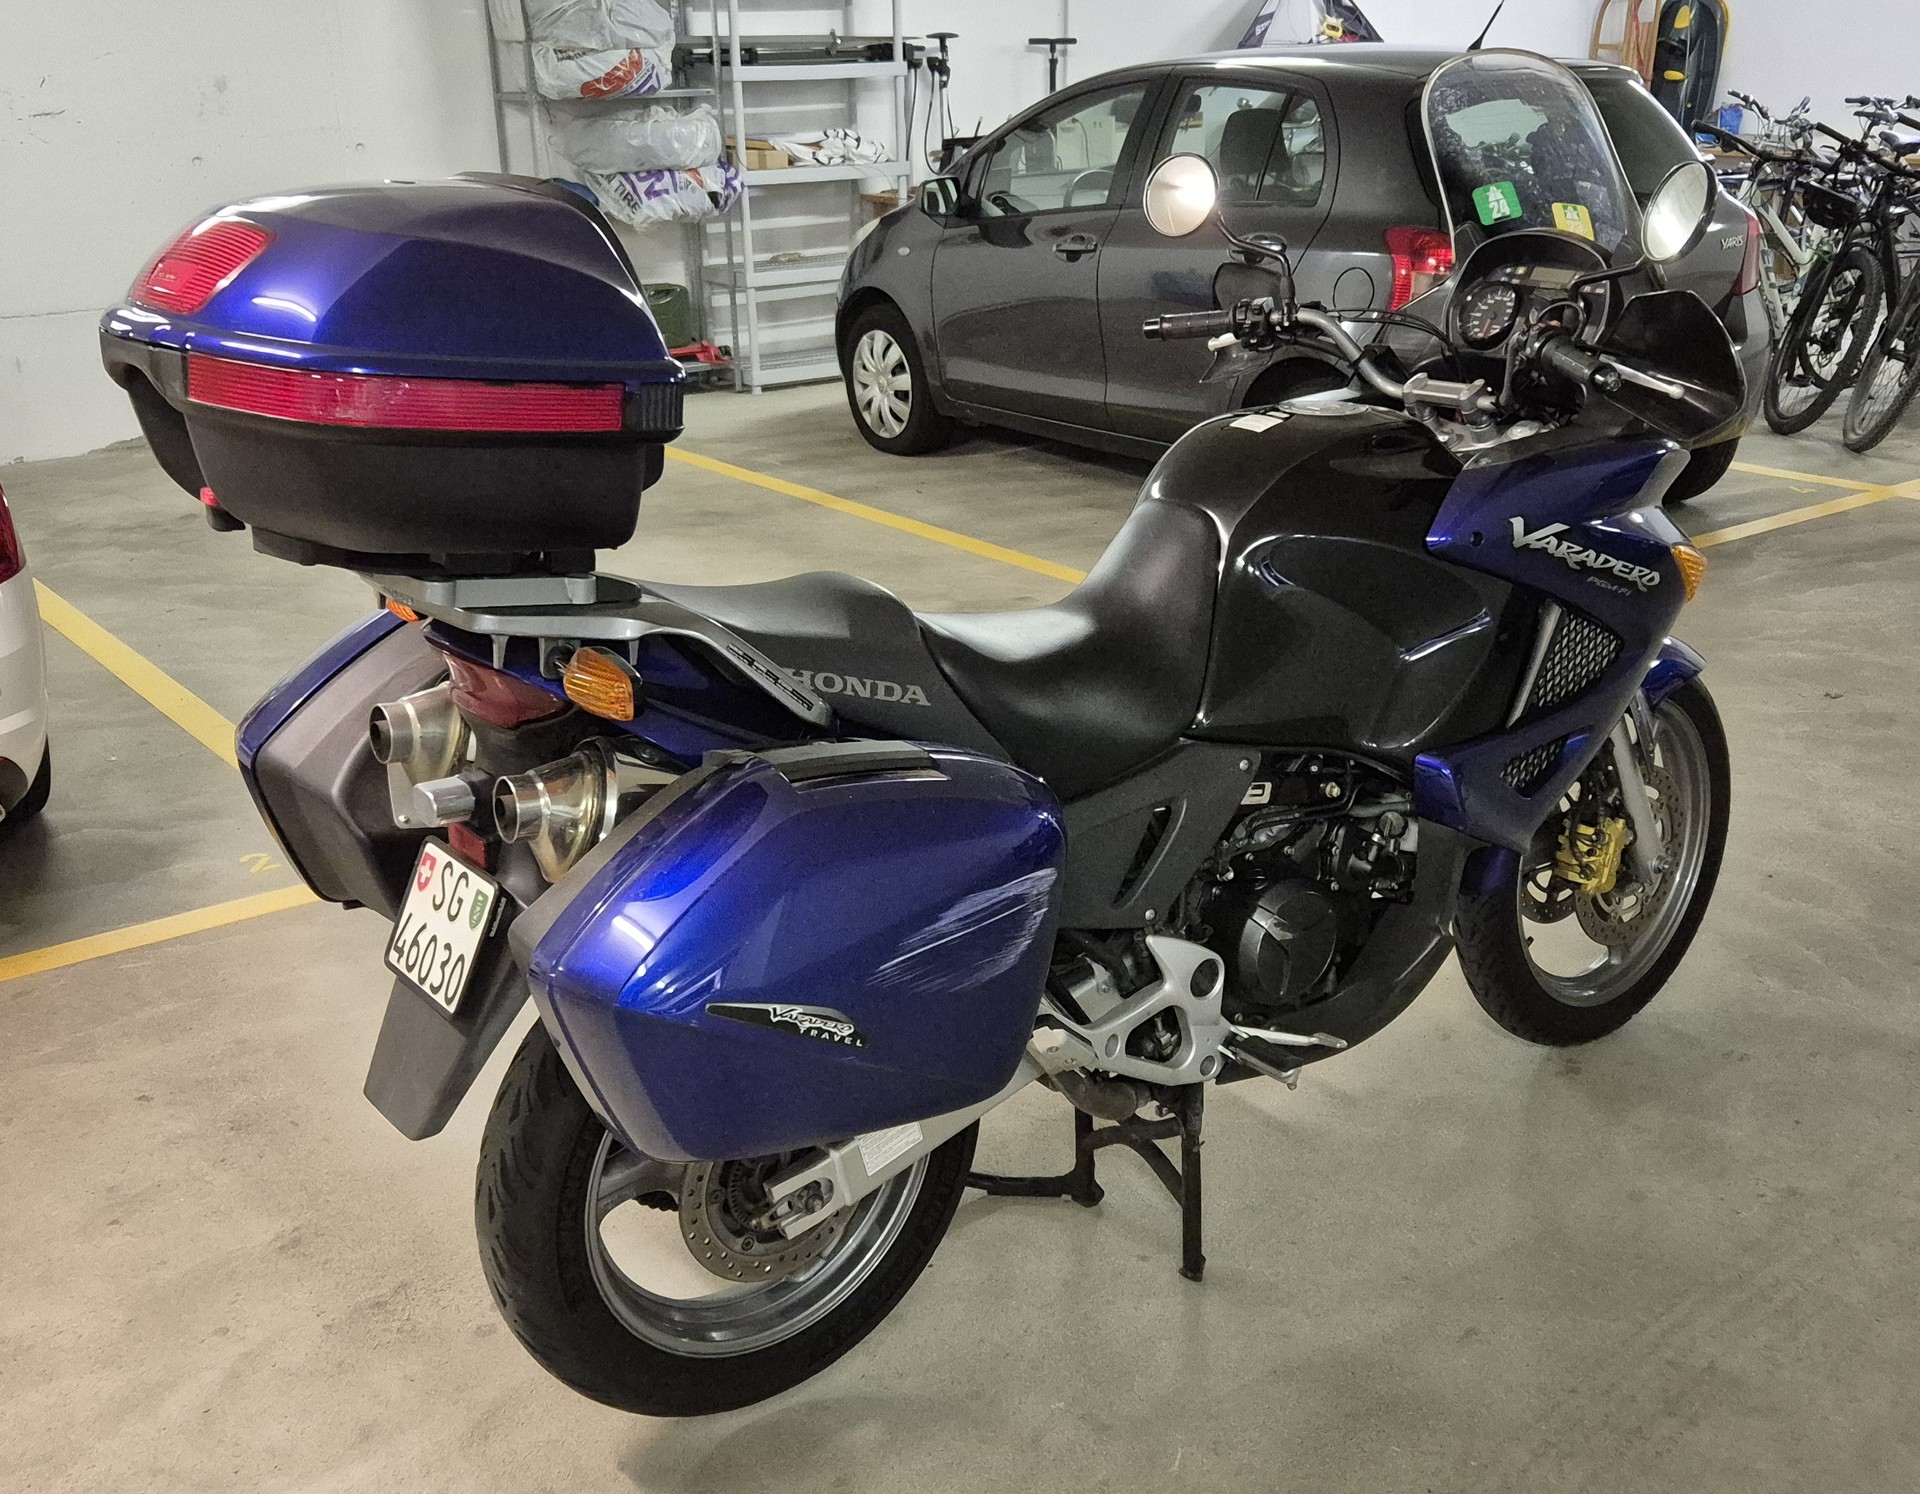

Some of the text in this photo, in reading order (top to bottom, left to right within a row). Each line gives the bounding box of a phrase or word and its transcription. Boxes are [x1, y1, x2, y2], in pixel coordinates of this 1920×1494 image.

[612, 182, 642, 215] TIRE
[1721, 235, 1744, 251] YARIS
[1509, 516, 1661, 592] VARADERO
[432, 861, 470, 922] SG
[393, 912, 466, 1006] 46030
[799, 1026, 864, 1047] TRAVEL
